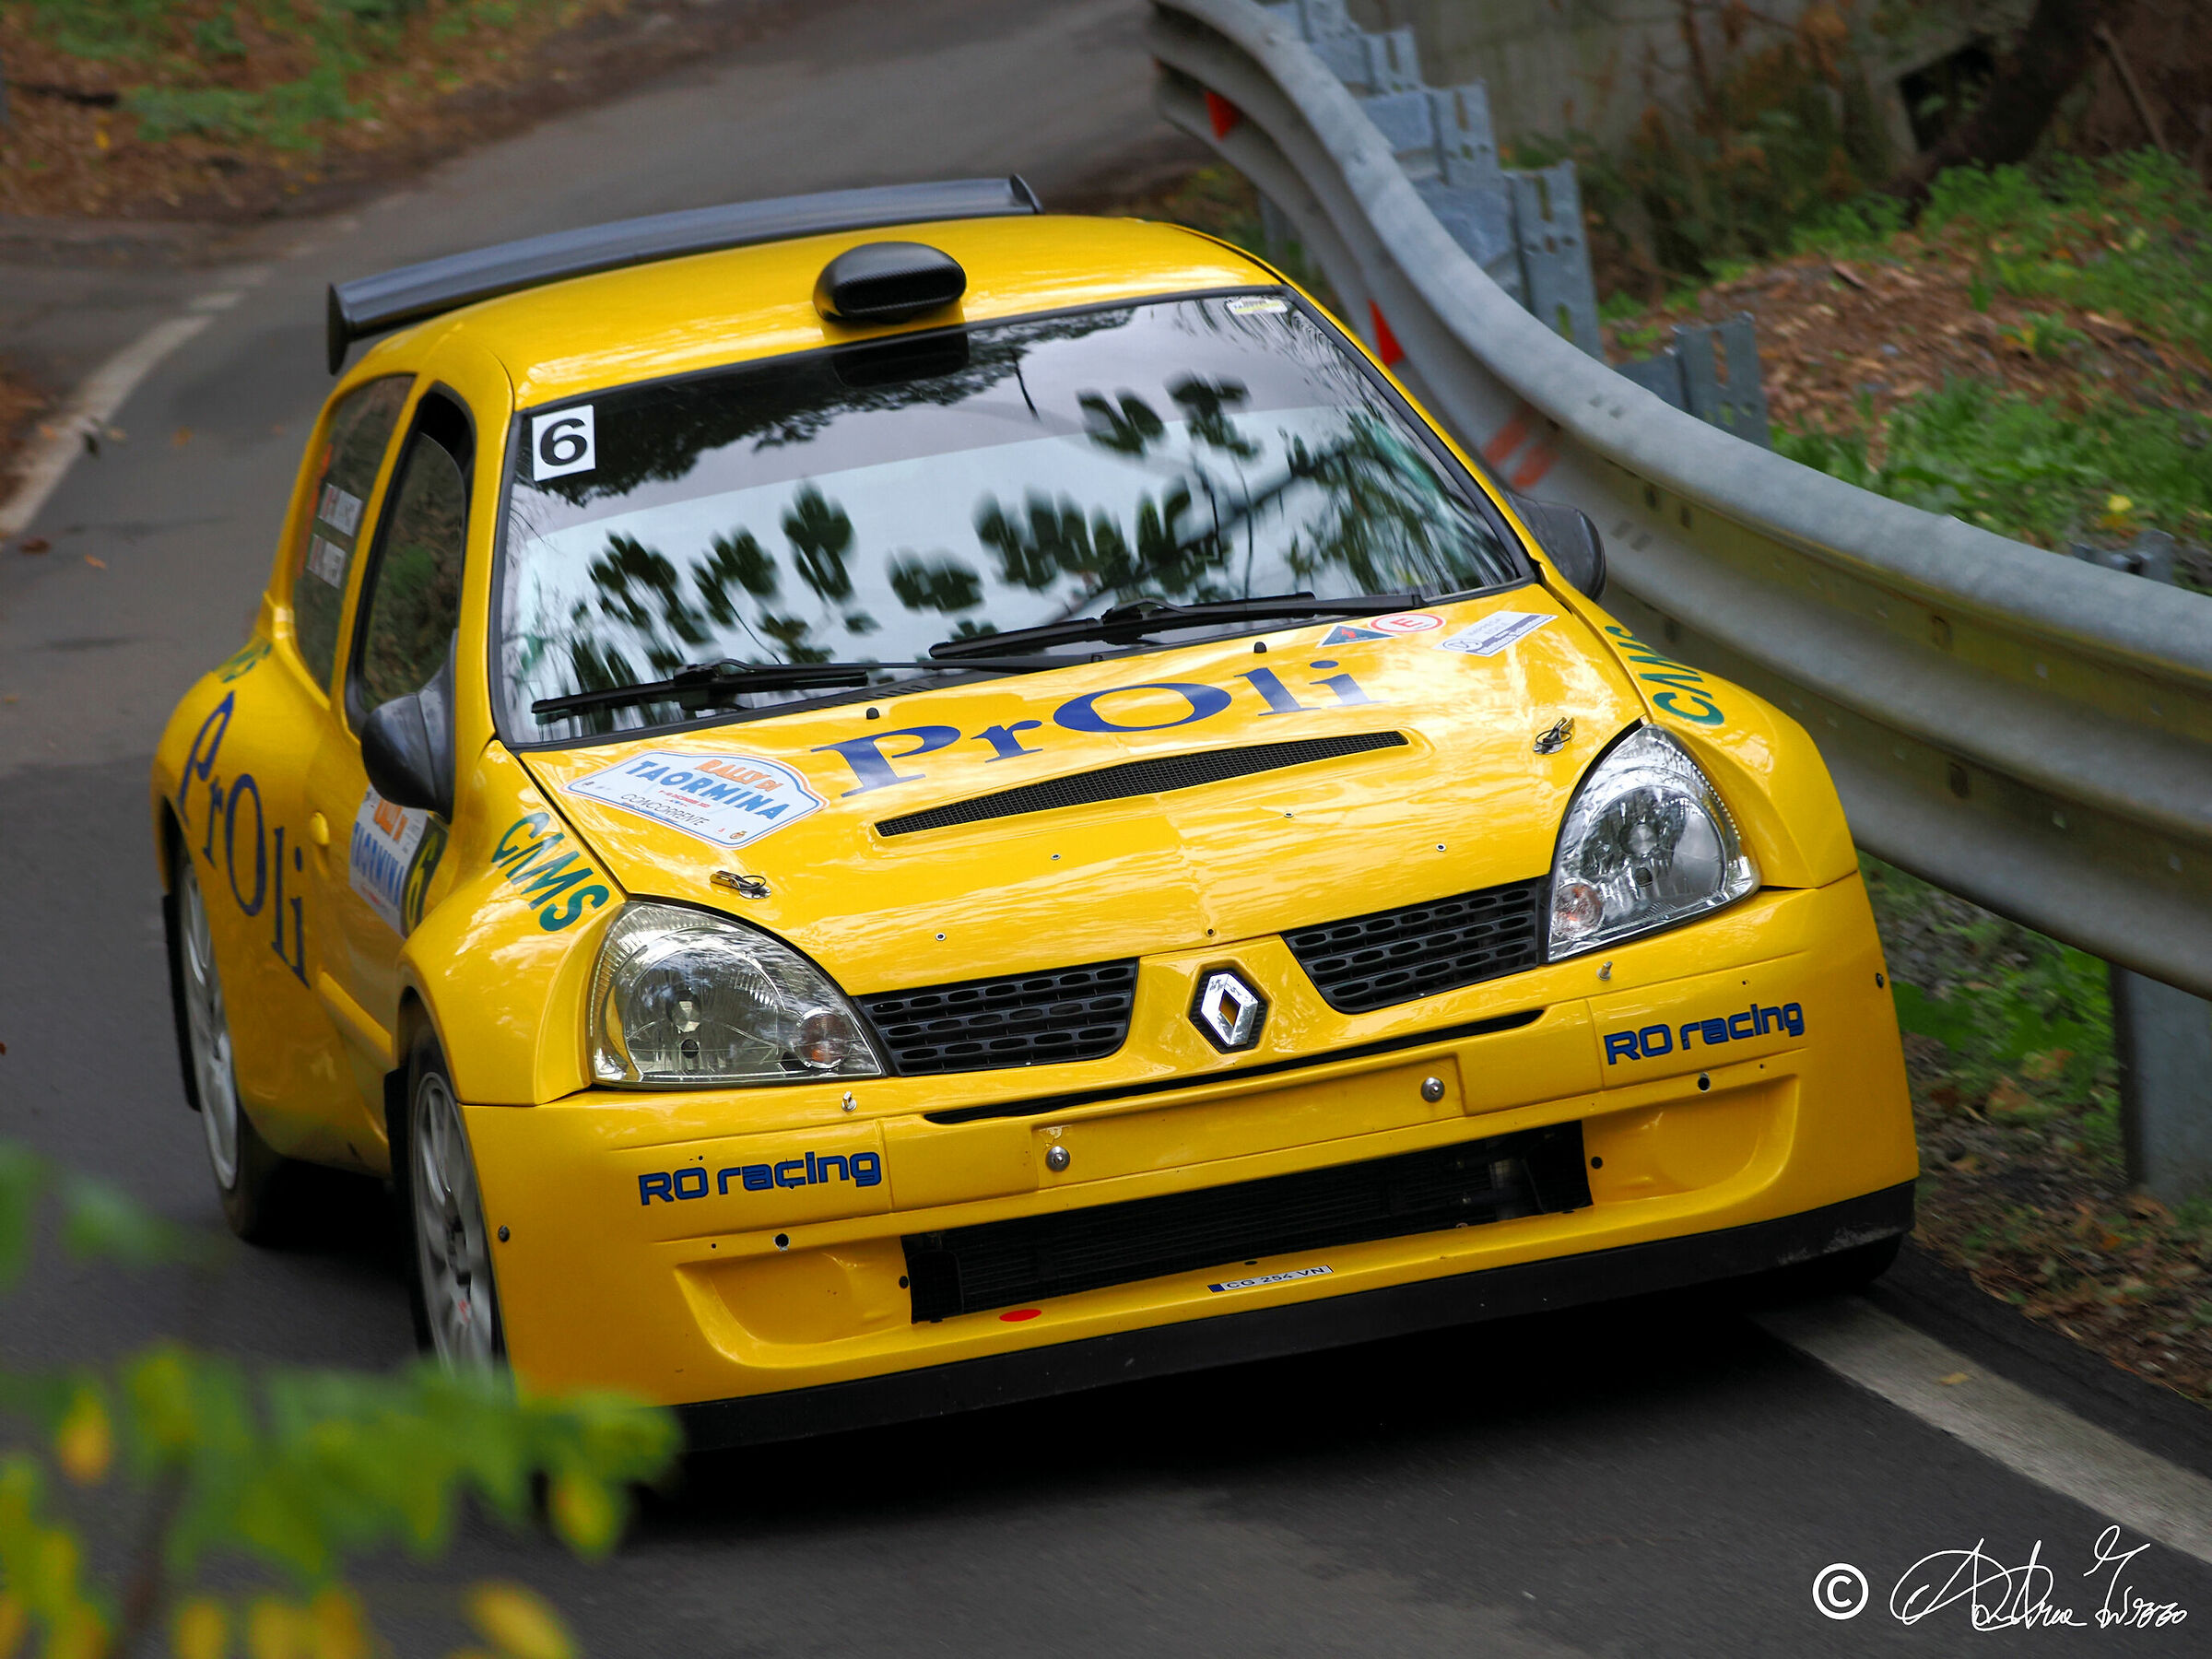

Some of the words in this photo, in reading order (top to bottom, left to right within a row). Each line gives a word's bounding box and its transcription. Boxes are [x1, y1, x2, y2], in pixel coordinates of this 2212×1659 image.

[540, 418, 587, 466] 6
[811, 661, 1389, 798] PrOli
[626, 760, 791, 820] TAORMINA
[694, 759, 771, 785] RALLY
[620, 793, 711, 827] CONCORRENTE
[178, 689, 311, 990] PrOli
[491, 812, 610, 932] CAMS
[1603, 1023, 1674, 1066] RO
[1679, 1002, 1805, 1052] racing
[638, 1166, 709, 1206] RO
[717, 1151, 882, 1195] racing
[1227, 1280, 1255, 1288] CG
[1261, 1274, 1293, 1283] 254
[1297, 1267, 1325, 1277] VN
